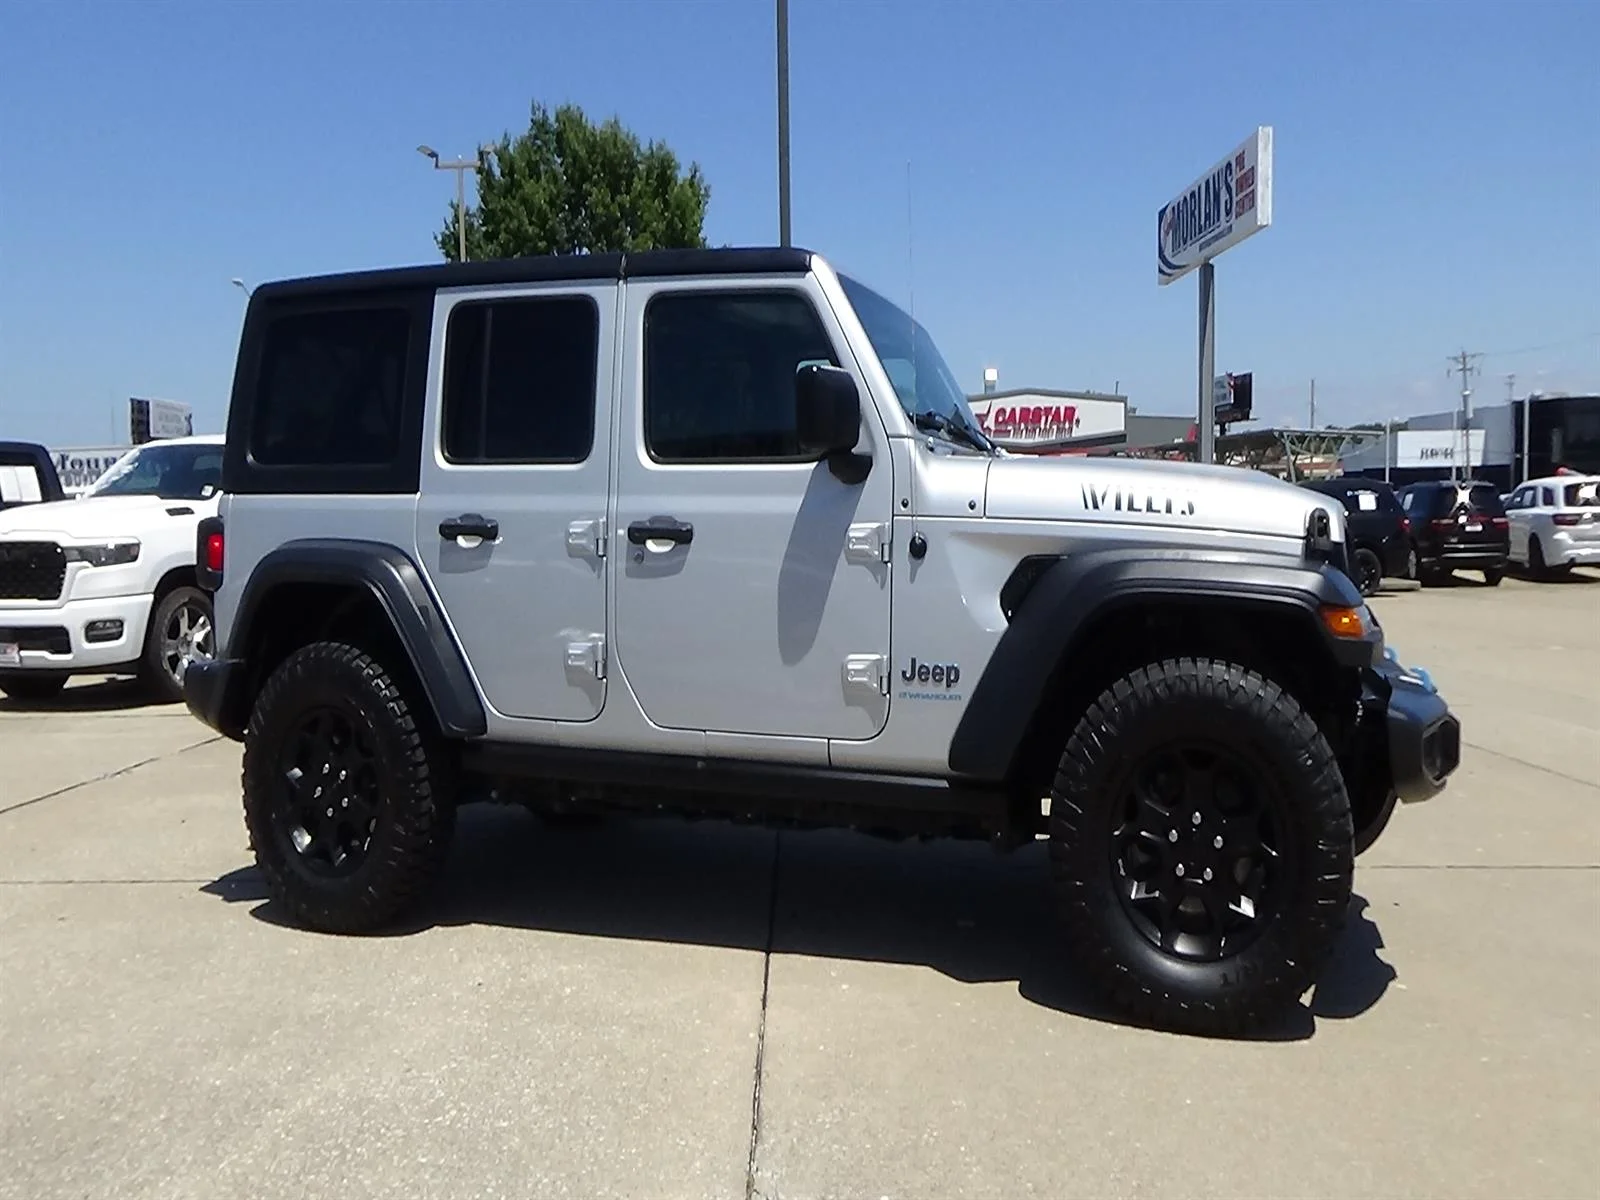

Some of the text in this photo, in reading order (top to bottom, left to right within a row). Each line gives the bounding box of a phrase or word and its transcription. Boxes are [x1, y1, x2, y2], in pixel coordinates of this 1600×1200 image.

[1171, 160, 1234, 254] MORLAN'S
[994, 406, 1076, 428] CARSTAR
[901, 657, 961, 688] Jeep
